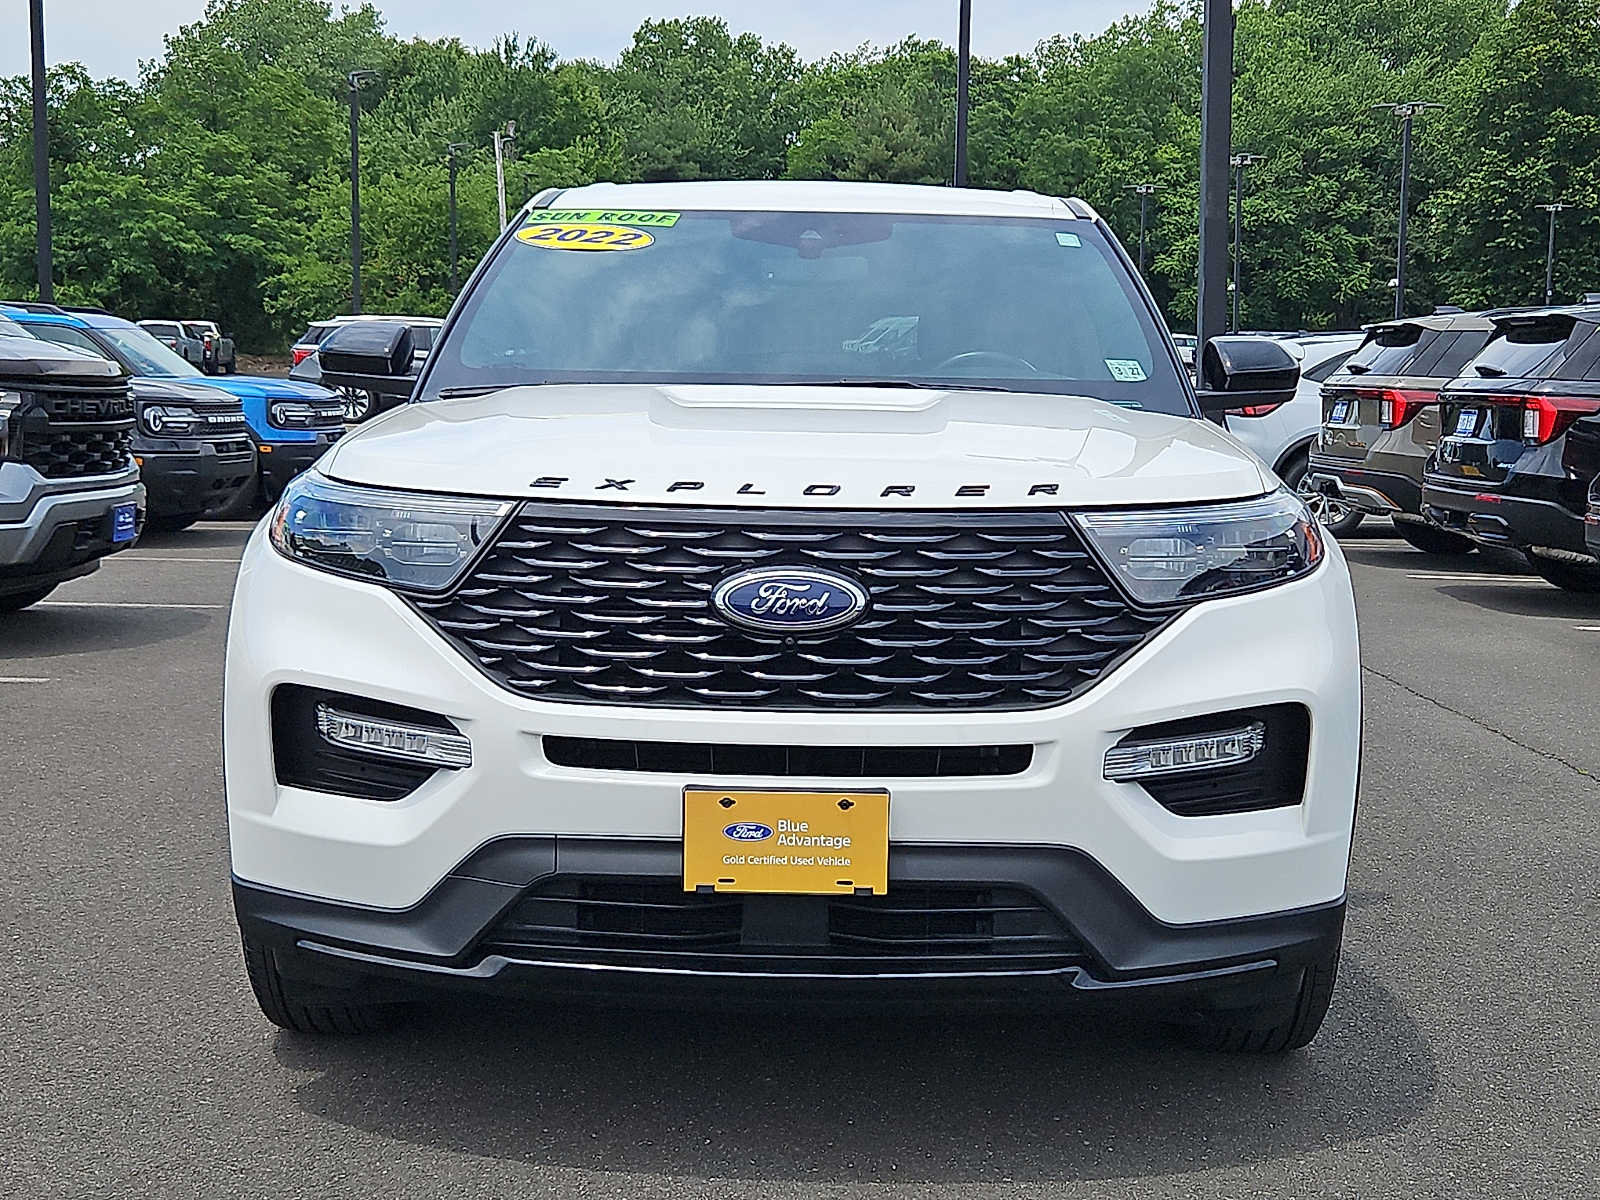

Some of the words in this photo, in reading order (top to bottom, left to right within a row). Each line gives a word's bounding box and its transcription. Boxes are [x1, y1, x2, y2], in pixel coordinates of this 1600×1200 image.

[532, 212, 591, 222] SUN
[598, 212, 679, 224] ROOF
[527, 228, 643, 246] 2022
[530, 477, 1061, 496] EXPLORER
[750, 582, 830, 615] Ford
[733, 823, 765, 839] Ford
[777, 819, 809, 833] Blue
[776, 834, 851, 849] Advantage
[722, 855, 745, 865] Gold
[747, 855, 788, 865] Certified
[790, 856, 814, 866] Used
[817, 856, 851, 866] Vehicle
